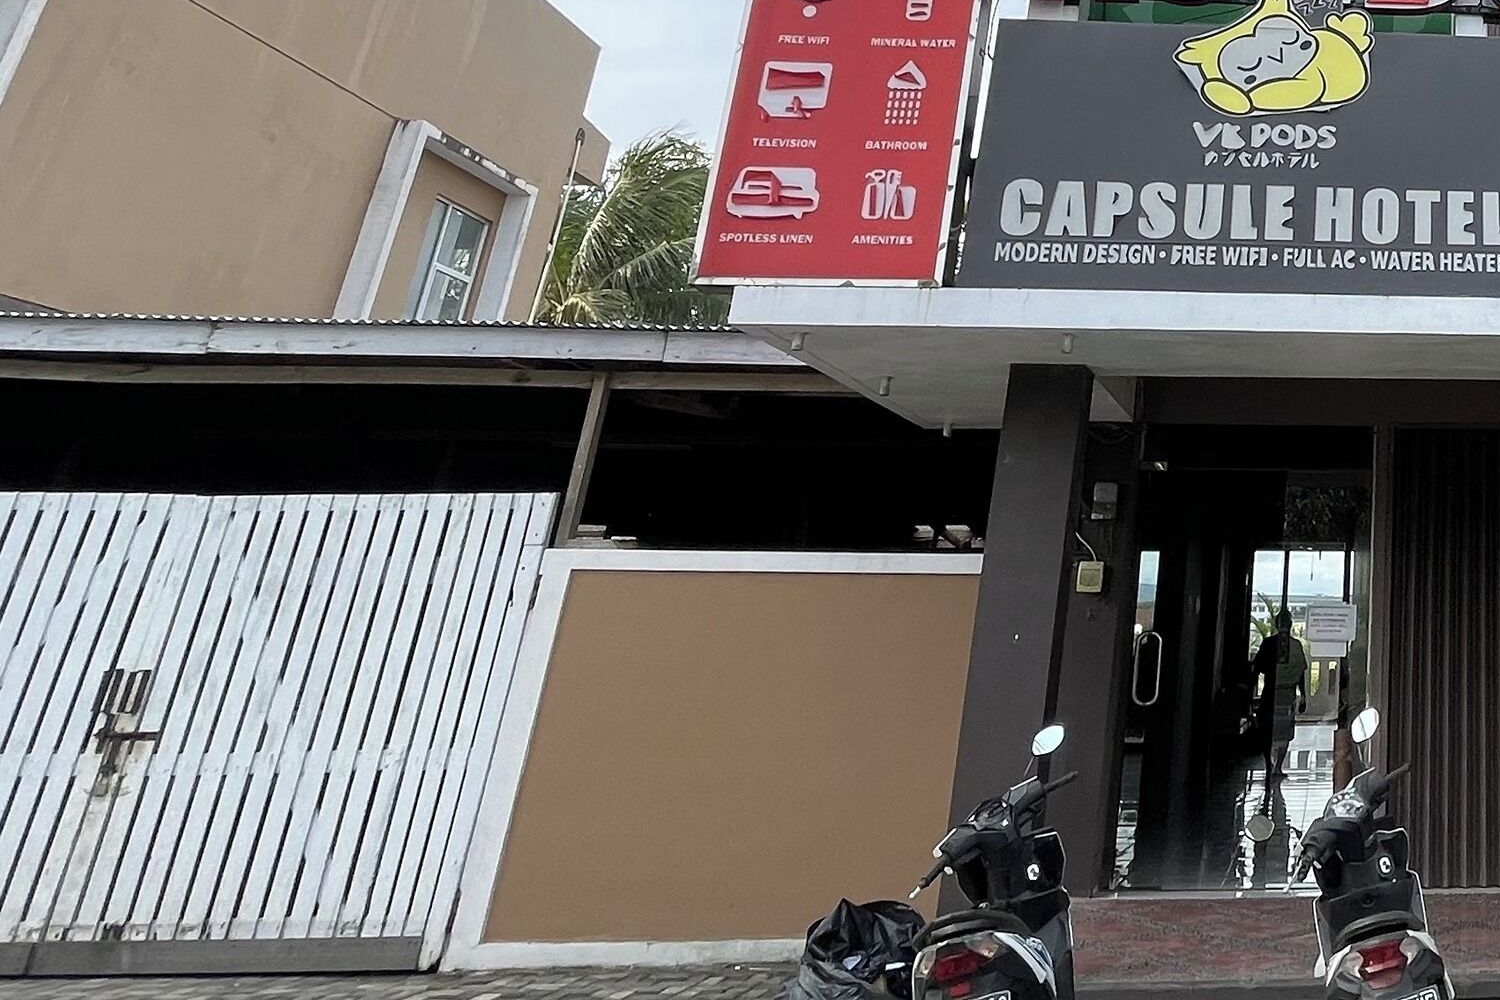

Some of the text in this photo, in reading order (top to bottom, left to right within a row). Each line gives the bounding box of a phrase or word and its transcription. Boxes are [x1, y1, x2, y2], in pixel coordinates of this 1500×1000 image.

[778, 34, 804, 45] FREE
[870, 37, 956, 48] MINERAL WATER
[1251, 122, 1337, 150] PODS
[752, 137, 816, 149] TELEVISION
[865, 140, 928, 151] BATHROOM
[999, 178, 1296, 241] CAPSULE
[718, 232, 814, 244] SPOTLESS LINEN
[851, 234, 914, 246] AMENITIES
[994, 241, 1079, 264] MODERN
[1082, 243, 1156, 265] DESIGN
[1170, 244, 1217, 266] FREE
[1221, 246, 1268, 267] WIFI
[1283, 248, 1327, 269] FULL
[1330, 249, 1356, 269] AC
[1370, 250, 1435, 272] WATER
